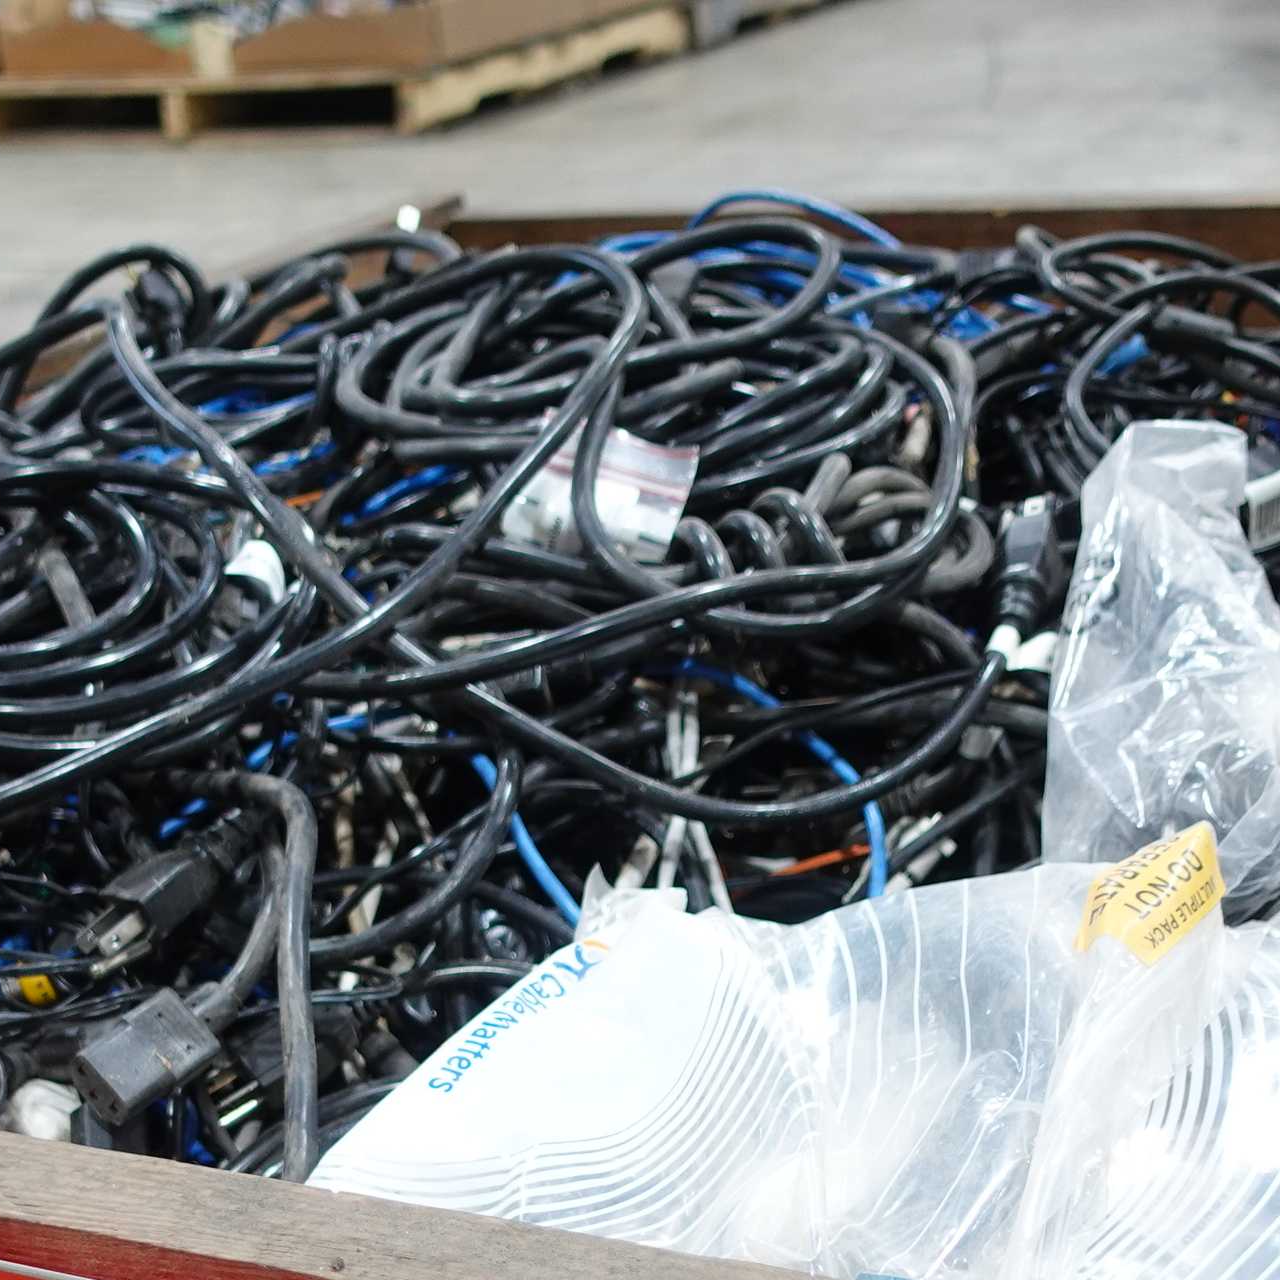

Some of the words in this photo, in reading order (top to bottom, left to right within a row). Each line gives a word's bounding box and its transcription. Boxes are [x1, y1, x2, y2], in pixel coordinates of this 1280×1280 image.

[1167, 848, 1204, 883] DO
[1124, 876, 1178, 920] NOT
[1144, 912, 1180, 949] PACK
